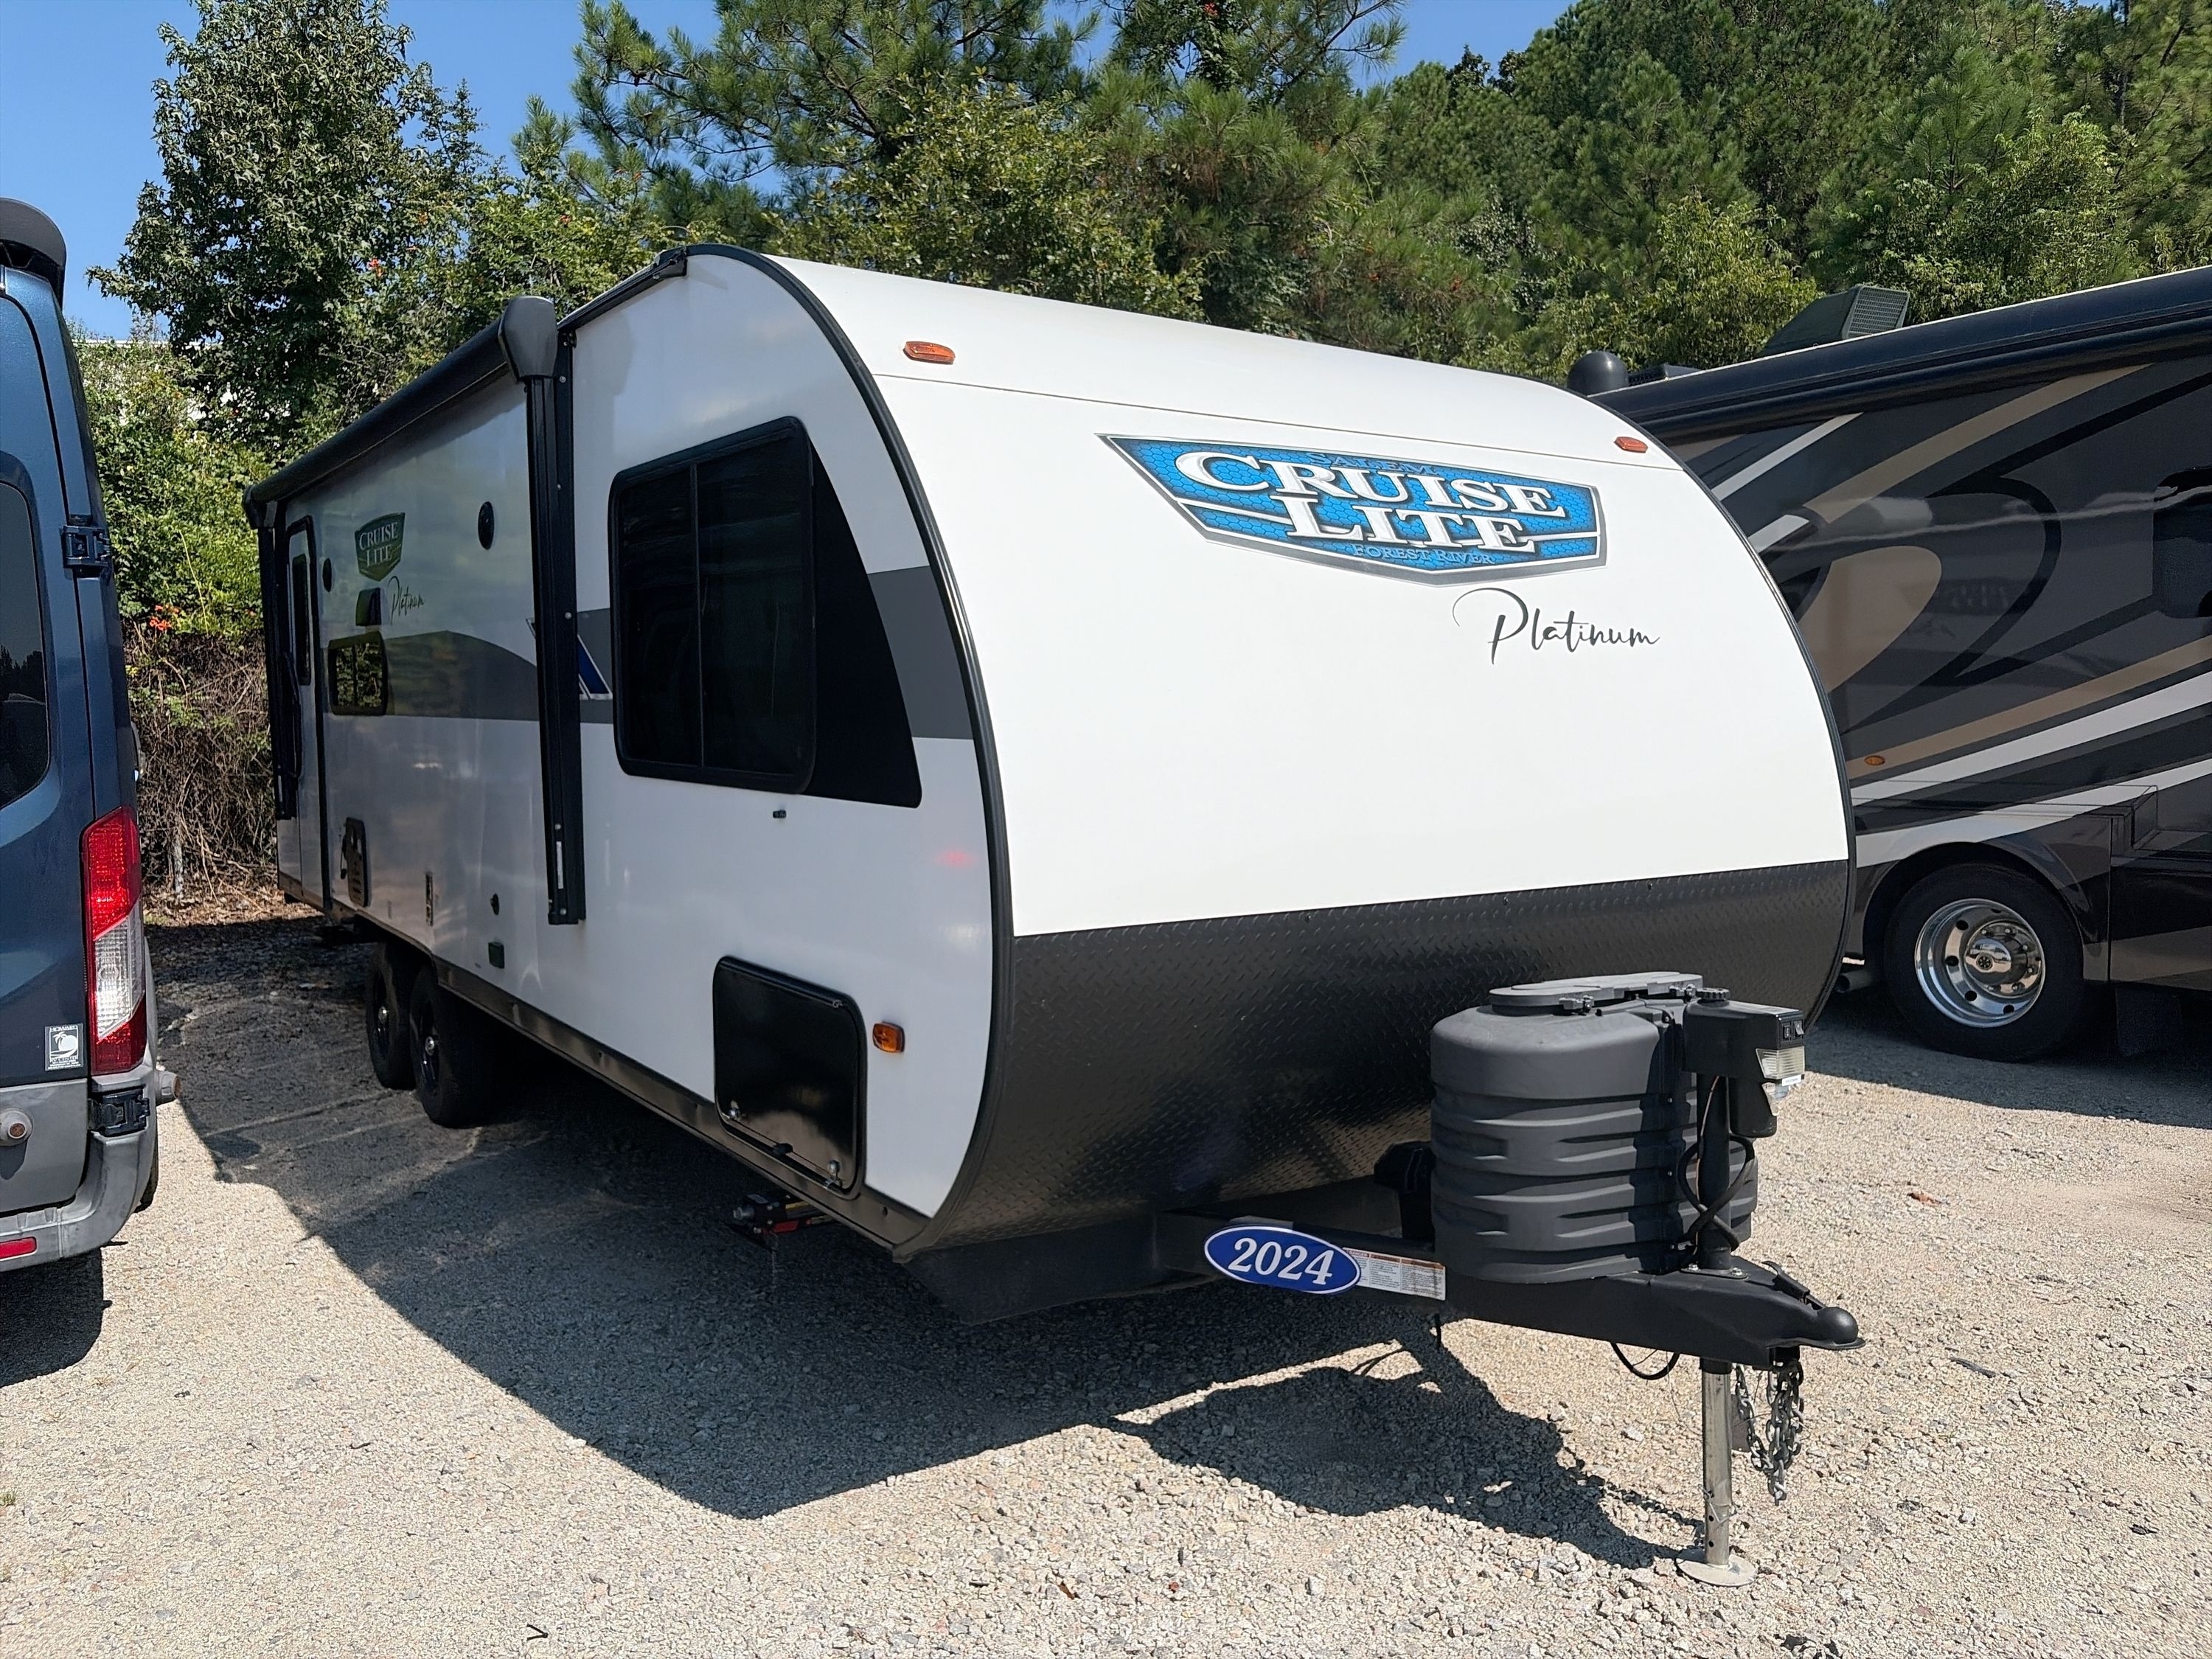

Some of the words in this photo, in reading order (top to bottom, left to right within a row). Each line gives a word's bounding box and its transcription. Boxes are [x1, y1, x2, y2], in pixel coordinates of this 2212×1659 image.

[1175, 451, 1566, 518] CRUISE
[1304, 452, 1438, 476] SALEM
[359, 521, 398, 550] CRUISE
[1269, 495, 1536, 553] LITE
[366, 544, 393, 567] LITE
[1351, 544, 1433, 561] FOREST
[1434, 550, 1495, 566] RIVER
[387, 575, 425, 626] Platinum
[1452, 587, 1660, 665] Platinum
[1228, 1237, 1335, 1285] 2024
